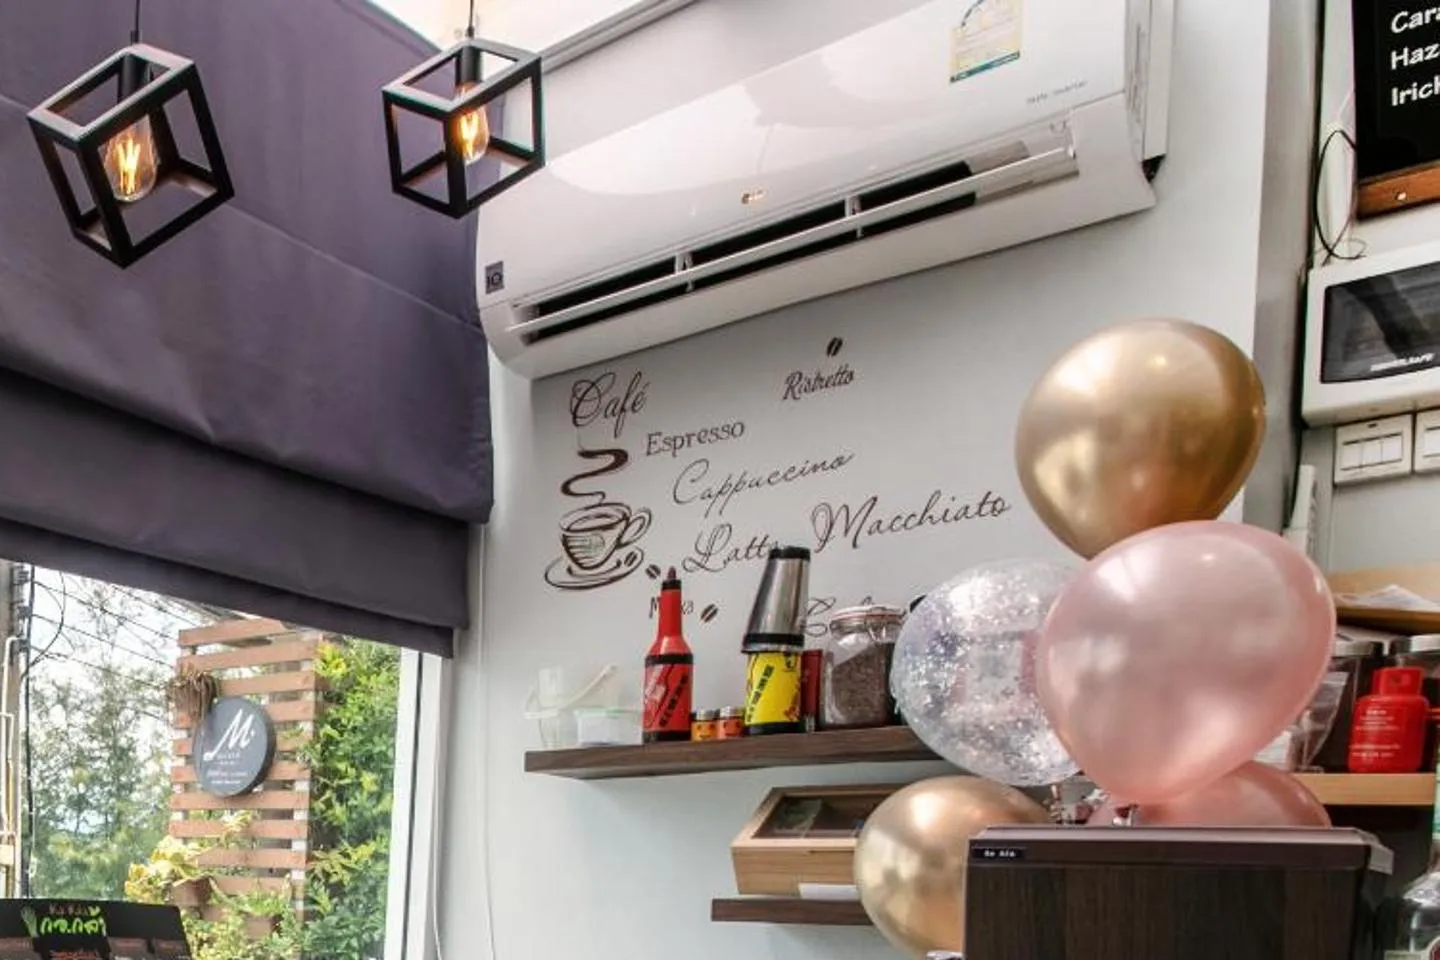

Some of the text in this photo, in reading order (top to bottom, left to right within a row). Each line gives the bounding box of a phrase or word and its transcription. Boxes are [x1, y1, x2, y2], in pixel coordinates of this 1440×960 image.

[569, 370, 650, 439] Café
[782, 363, 855, 401] Ristretto
[646, 421, 746, 458] Espresso
[673, 451, 857, 519] Cappuccino
[682, 489, 1012, 574] Latt Macchiato
